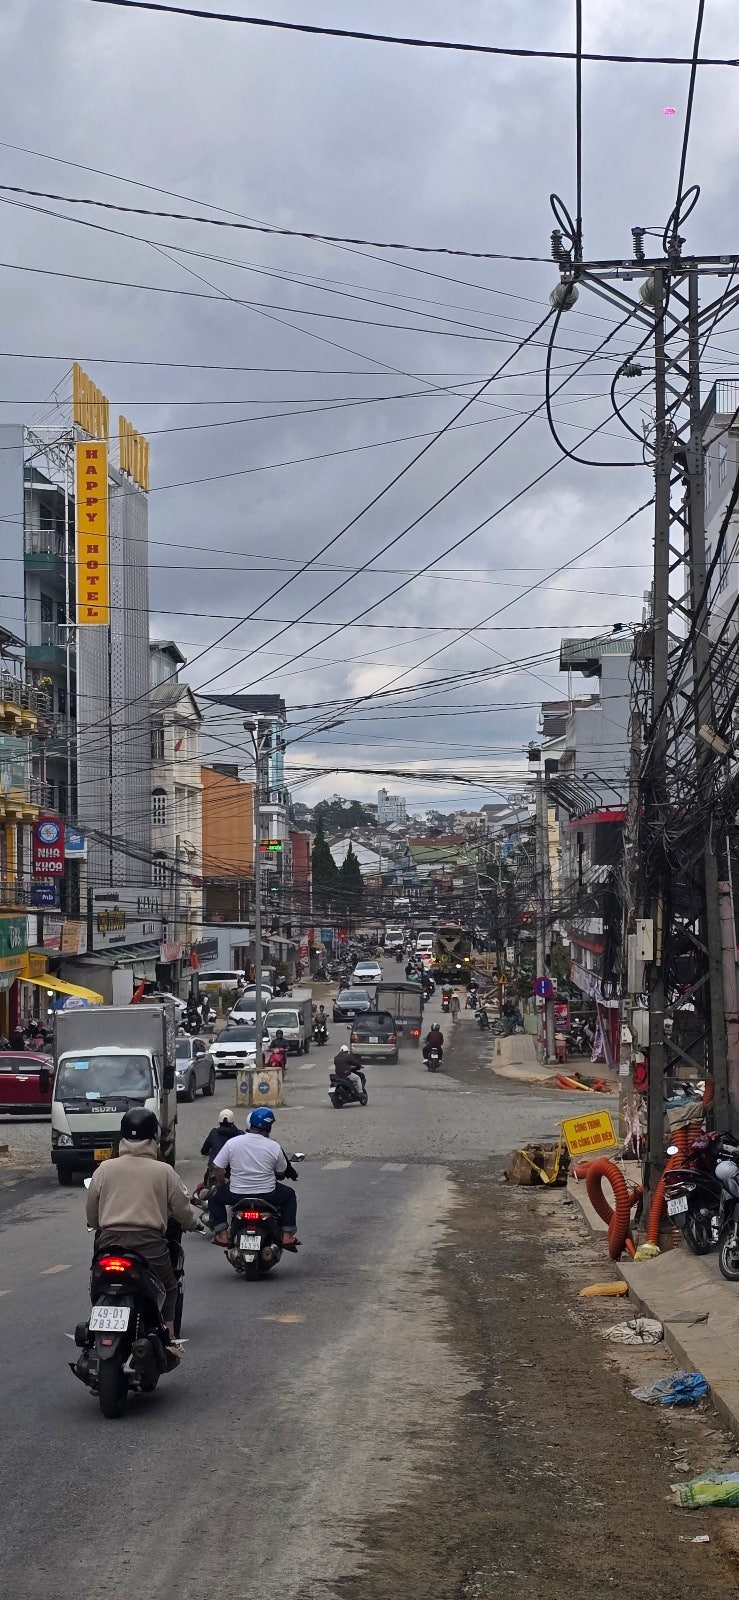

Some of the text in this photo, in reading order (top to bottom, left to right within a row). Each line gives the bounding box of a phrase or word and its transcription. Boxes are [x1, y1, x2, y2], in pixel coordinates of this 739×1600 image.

[85, 449, 99, 617] HAPPY HOTEL
[37, 848, 60, 858] NHA
[35, 861, 63, 872] KHOA
